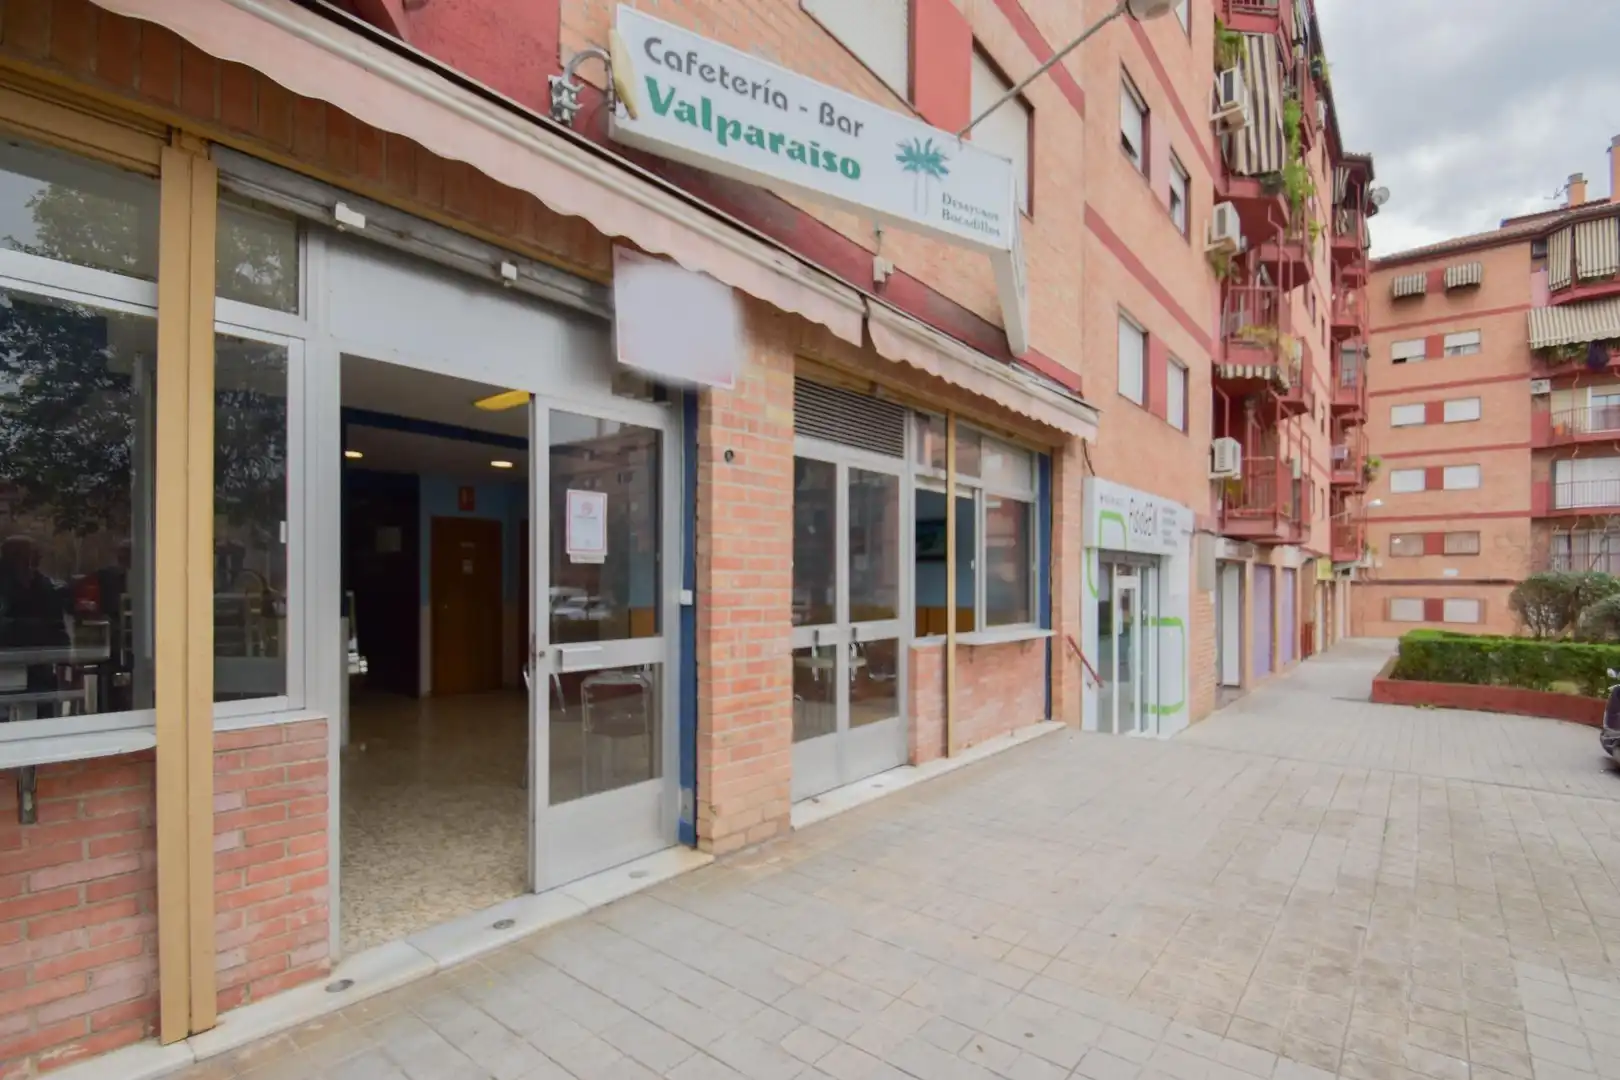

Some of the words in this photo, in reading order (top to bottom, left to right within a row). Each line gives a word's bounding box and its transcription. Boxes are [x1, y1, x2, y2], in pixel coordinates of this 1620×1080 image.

[643, 36, 789, 113] Cafetería
[818, 102, 864, 138] Bar
[644, 74, 861, 181] Valparaiso
